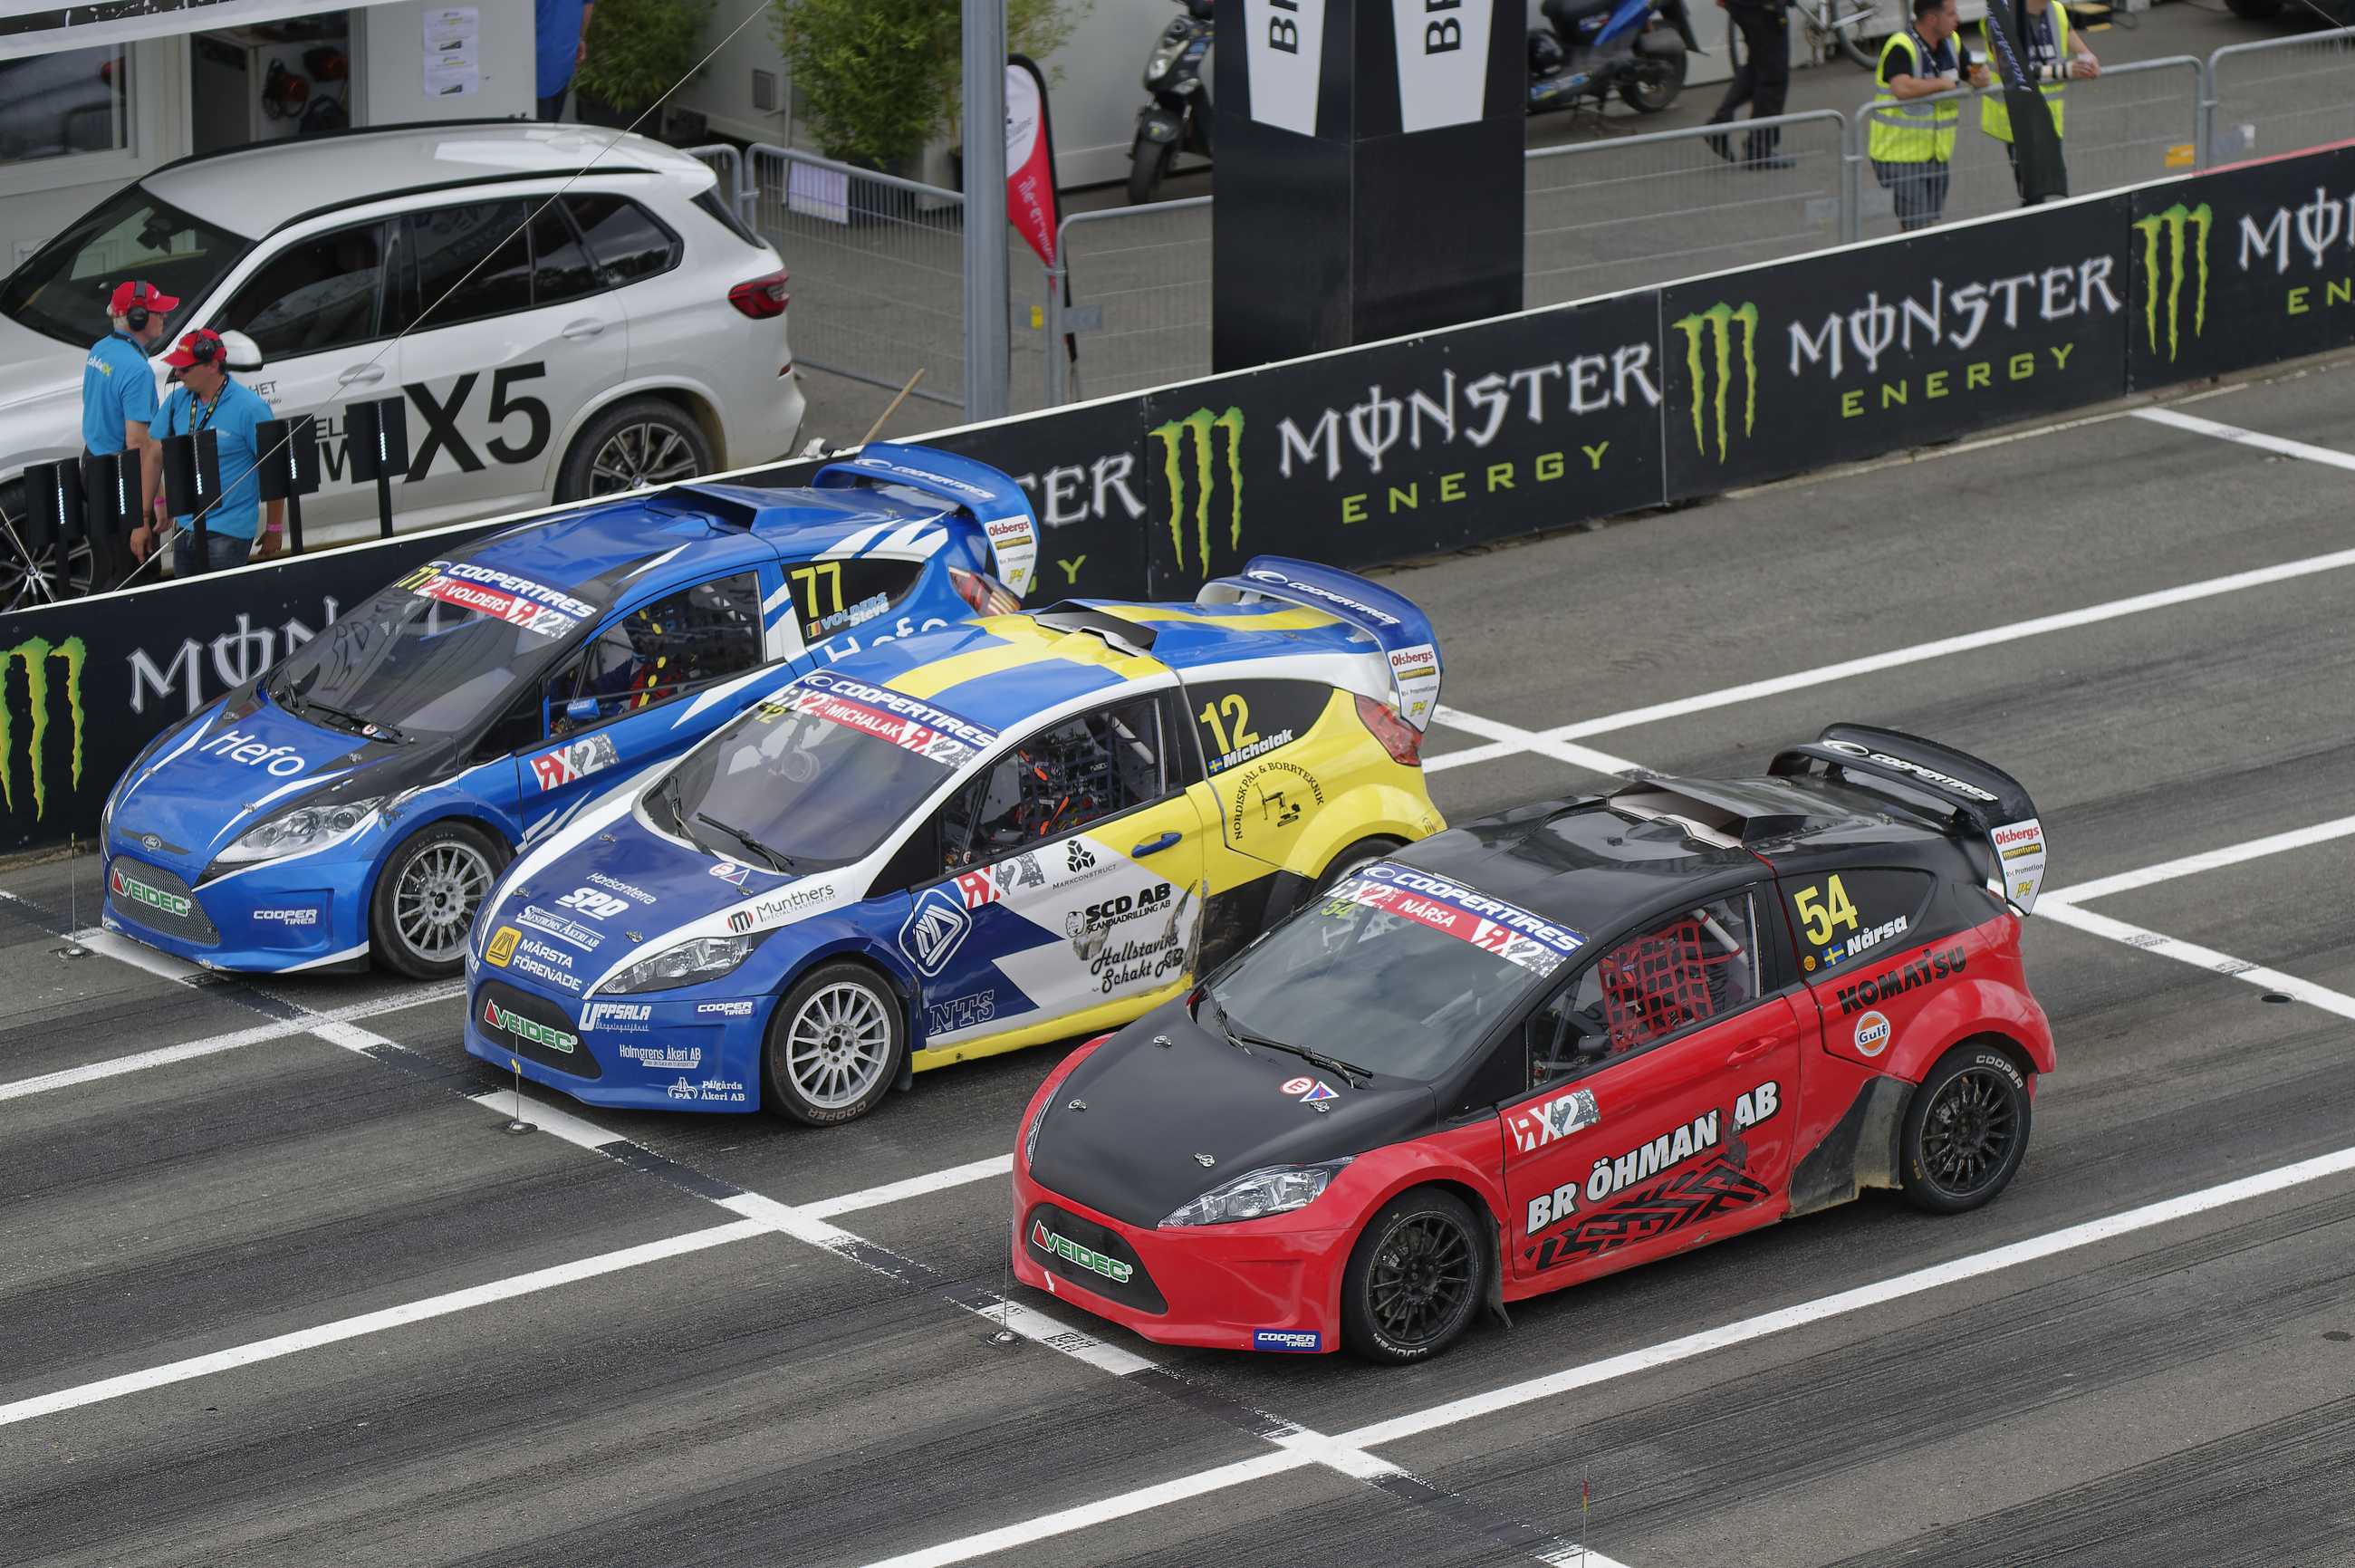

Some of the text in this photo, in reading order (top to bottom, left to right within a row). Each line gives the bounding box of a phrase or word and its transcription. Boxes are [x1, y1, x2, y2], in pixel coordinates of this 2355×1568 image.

[1786, 255, 2122, 380] MONSTER
[1841, 343, 2074, 418] ENERGY
[402, 361, 551, 484] X5
[1276, 341, 1663, 481] MONSTER
[1342, 441, 1610, 524] ENERGY
[988, 520, 1030, 537] Olsbergs
[446, 584, 511, 612] VOLDERS
[791, 561, 844, 618] 77
[821, 592, 889, 630] VOLDERS
[850, 601, 890, 628] Steve
[1391, 650, 1434, 667] Olsbergs
[826, 705, 903, 738] MICHALAK
[1199, 694, 1260, 755] 12
[199, 729, 305, 776] Hefo
[1224, 729, 1293, 768] Michalak
[1234, 785, 1247, 841] NORDISK
[1268, 762, 1324, 806] BORRTEKNIK
[1995, 826, 2040, 845] Olsbergs
[1053, 864, 1117, 890] MARKCONSTRUCT
[2015, 863, 2043, 876] Promotion
[120, 871, 188, 917] VEIDEC
[558, 887, 630, 919] SPD
[756, 884, 834, 923] Munthers
[1086, 882, 1171, 925] SCD AB
[1159, 899, 1171, 910] AB
[1793, 873, 1859, 946] 54
[254, 909, 317, 920] COOPER
[1399, 898, 1457, 928] NÅRSA
[520, 938, 573, 968] MÄRSTA
[1846, 914, 1908, 957] Nårsa
[513, 954, 582, 991] FÖRENADE
[1101, 961, 1152, 994] Schakt
[1836, 946, 1966, 1015] KOMATSU
[579, 1003, 652, 1032] UPPSALA
[697, 1001, 753, 1013] COOPER
[929, 989, 995, 1035] NTS
[492, 1003, 574, 1053] VEIDEC
[1859, 1024, 1889, 1043] Gulf
[620, 1044, 701, 1062] Holmgrens Åkeri AB
[1975, 1054, 2023, 1089] COOPER
[701, 1090, 745, 1101] Åkeri AB
[1526, 1080, 1782, 1236] BR ÖHMAN AB
[1041, 1225, 1130, 1284] VEIDEC
[1257, 1332, 1316, 1342] COOPER
